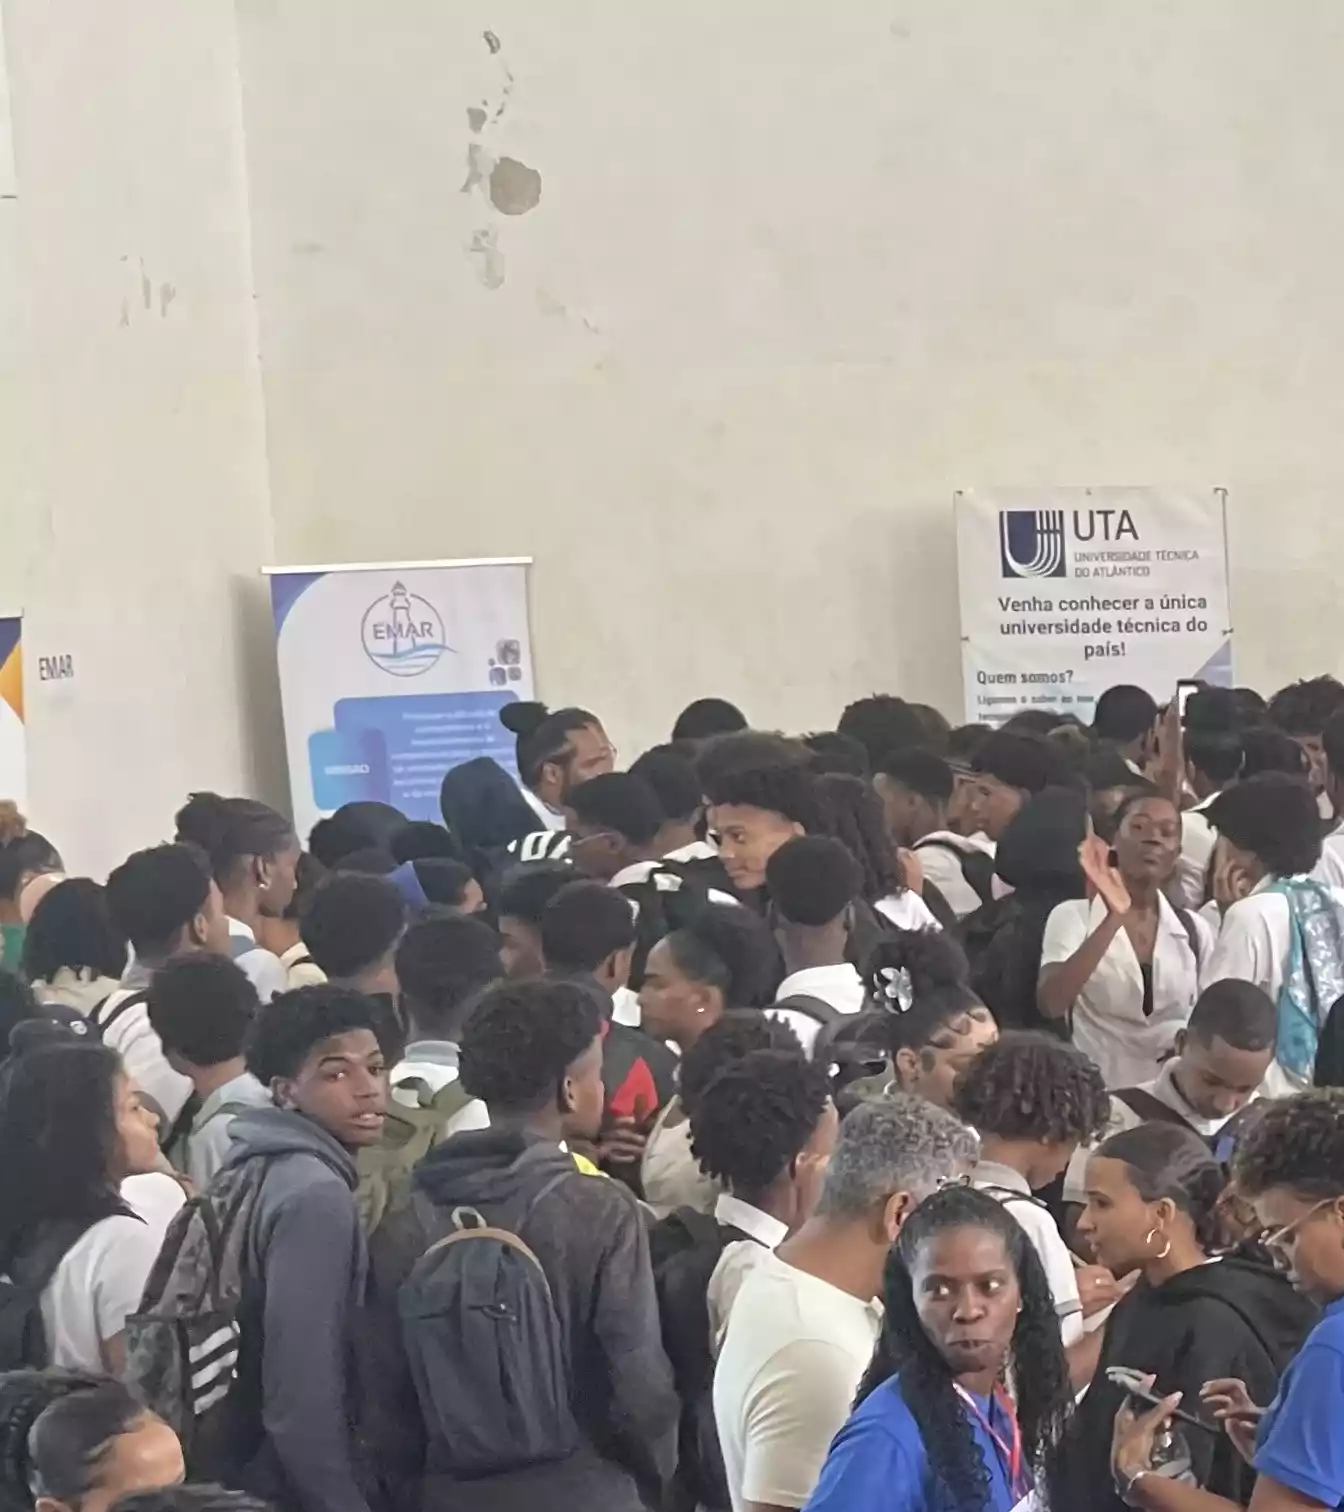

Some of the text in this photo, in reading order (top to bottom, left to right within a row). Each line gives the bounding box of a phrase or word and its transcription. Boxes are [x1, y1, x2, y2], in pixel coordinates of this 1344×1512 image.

[1073, 510, 1139, 541] UTA
[998, 593, 1207, 613] Venha conhecer a única
[372, 621, 434, 640] EMAR
[1000, 616, 1208, 635] universidade técnica do
[1084, 641, 1126, 660] país!
[39, 655, 74, 680] EMAR
[977, 670, 1074, 685] Quem somos?
